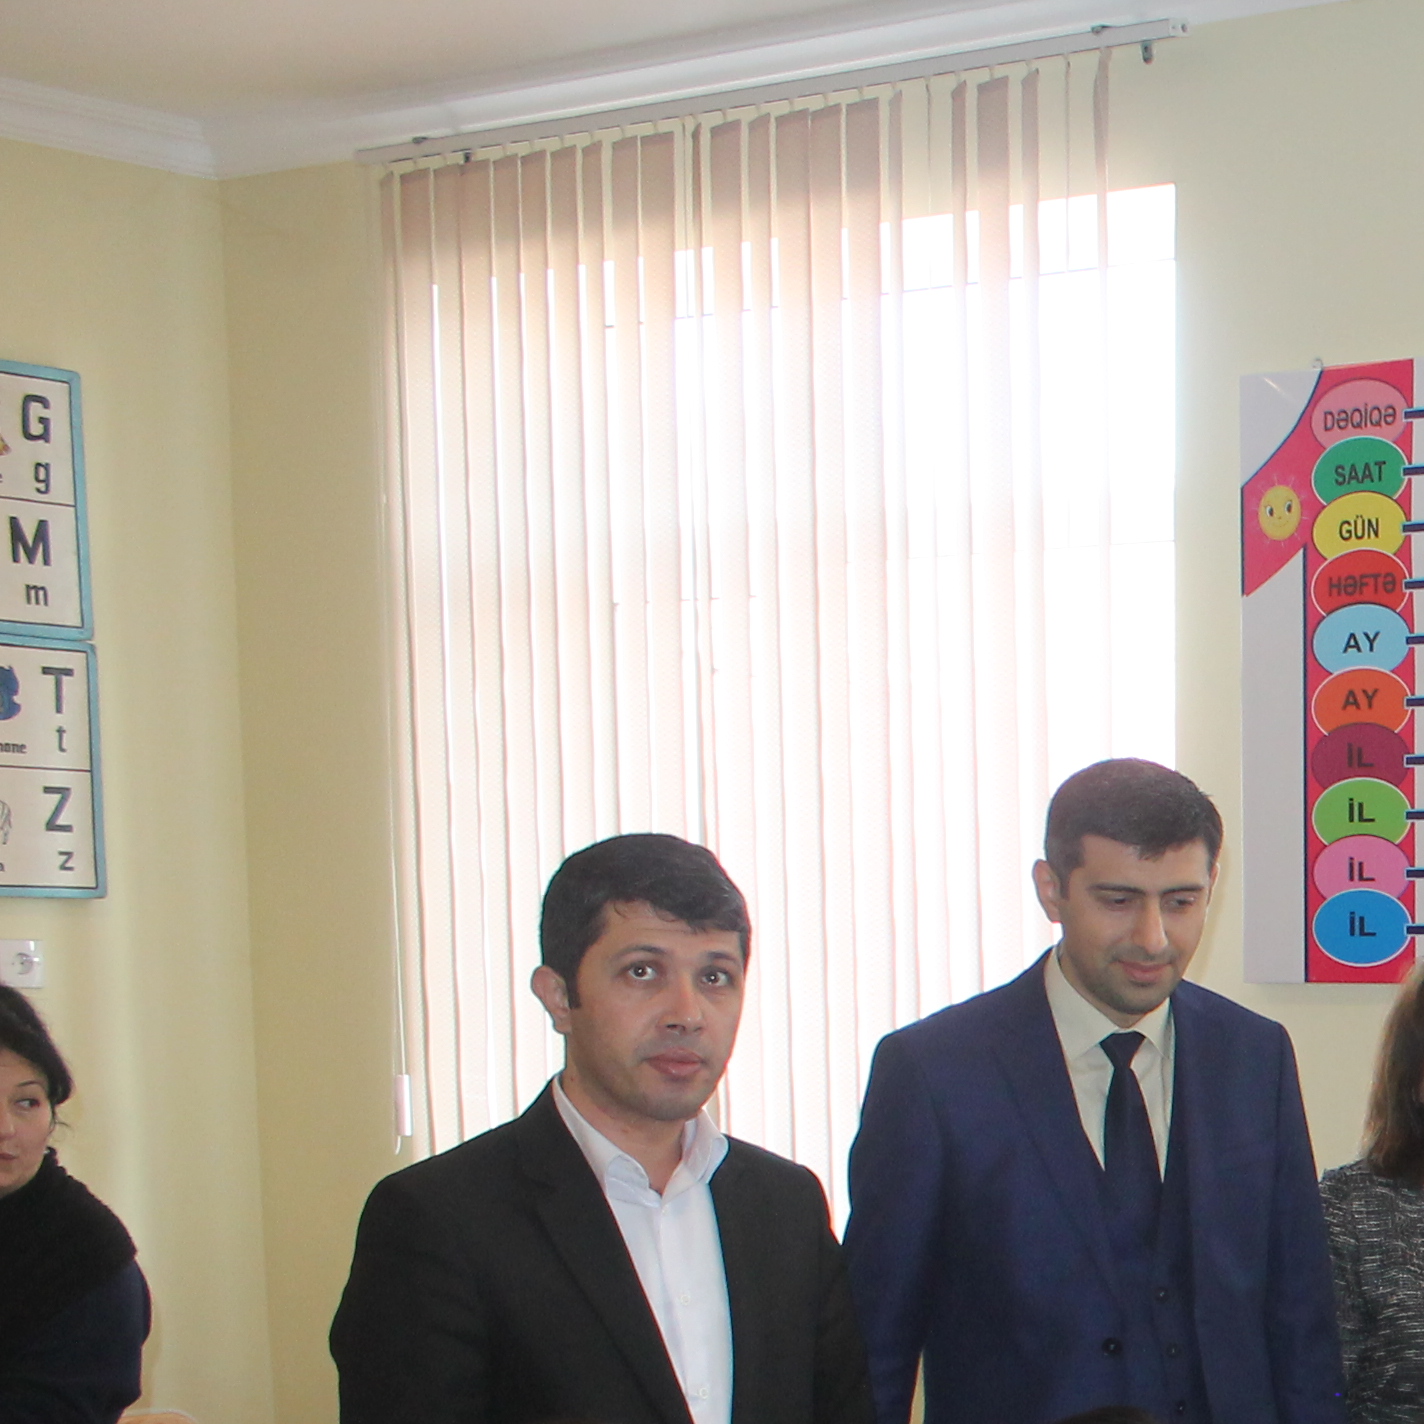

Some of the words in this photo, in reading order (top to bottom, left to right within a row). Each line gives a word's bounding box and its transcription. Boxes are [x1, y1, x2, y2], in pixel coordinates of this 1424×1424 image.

[22, 394, 51, 443] G
[1323, 404, 1397, 432] DƏQİQƏ
[34, 462, 51, 494] g
[1334, 461, 1386, 487] SAAT
[9, 516, 51, 566] M
[1339, 517, 1380, 542] GÜN
[25, 583, 49, 606] m
[1328, 571, 1396, 597] HƏFTƏ
[1343, 632, 1381, 653] AY
[41, 666, 75, 714] T
[1341, 689, 1379, 710] AY
[56, 725, 67, 752] t
[1346, 743, 1374, 768] İL
[43, 786, 74, 832] Z
[1348, 798, 1375, 823] İL
[58, 851, 75, 871] z
[1348, 857, 1375, 881] İL
[1349, 912, 1376, 937] İL
